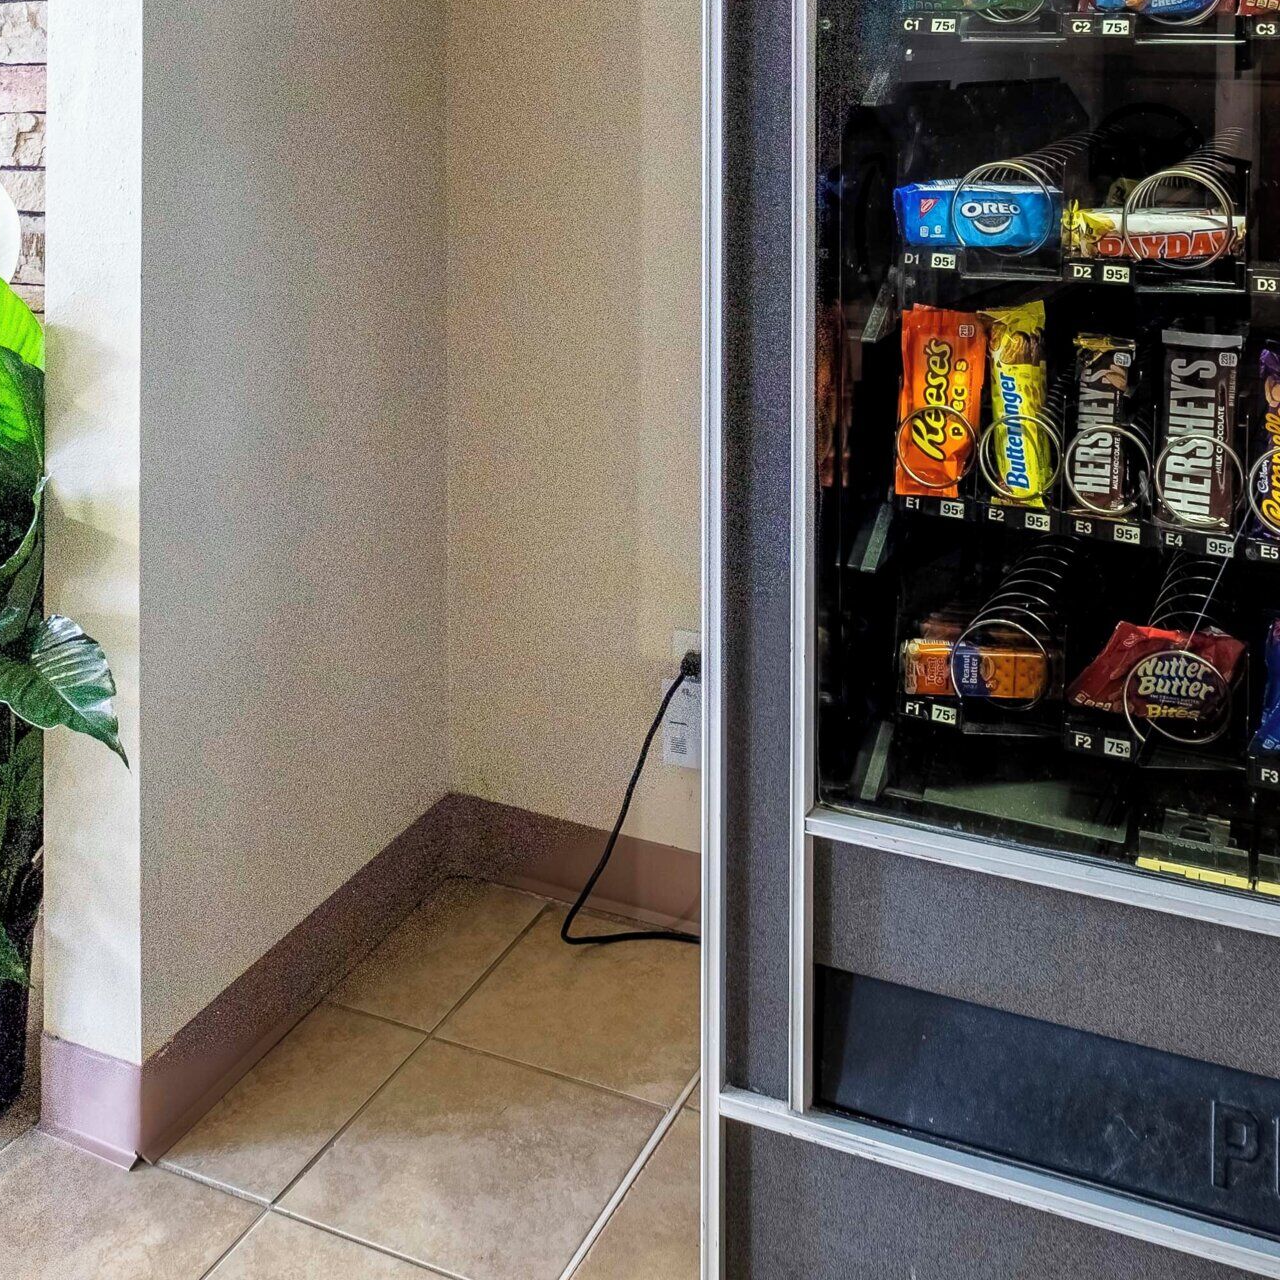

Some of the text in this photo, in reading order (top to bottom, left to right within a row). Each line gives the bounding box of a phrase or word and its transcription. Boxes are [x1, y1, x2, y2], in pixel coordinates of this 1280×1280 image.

[903, 20, 919, 31] C1
[1072, 22, 1091, 33] C2
[1255, 23, 1276, 35] C3
[961, 202, 1022, 217] OREO
[904, 253, 919, 264] D1
[1073, 266, 1092, 278] D2
[1257, 279, 1277, 290] D3
[912, 337, 953, 462] Reese's
[999, 371, 1031, 490] Butterfinger
[1073, 368, 1116, 494] HERSHEY'S
[1164, 358, 1218, 516] HERSHEY'S
[906, 498, 920, 509] E1
[988, 509, 1005, 521] E2
[1075, 521, 1092, 534] E3
[1166, 534, 1183, 547] E4
[1261, 547, 1279, 559] E5
[962, 654, 971, 684] Peanut
[969, 657, 979, 684] Butter
[1137, 656, 1213, 681] Nutter
[1137, 676, 1216, 701] Butter
[905, 702, 920, 715] F1
[1146, 704, 1201, 719] Bites
[1075, 734, 1092, 749] F2
[1260, 769, 1279, 783] F3
